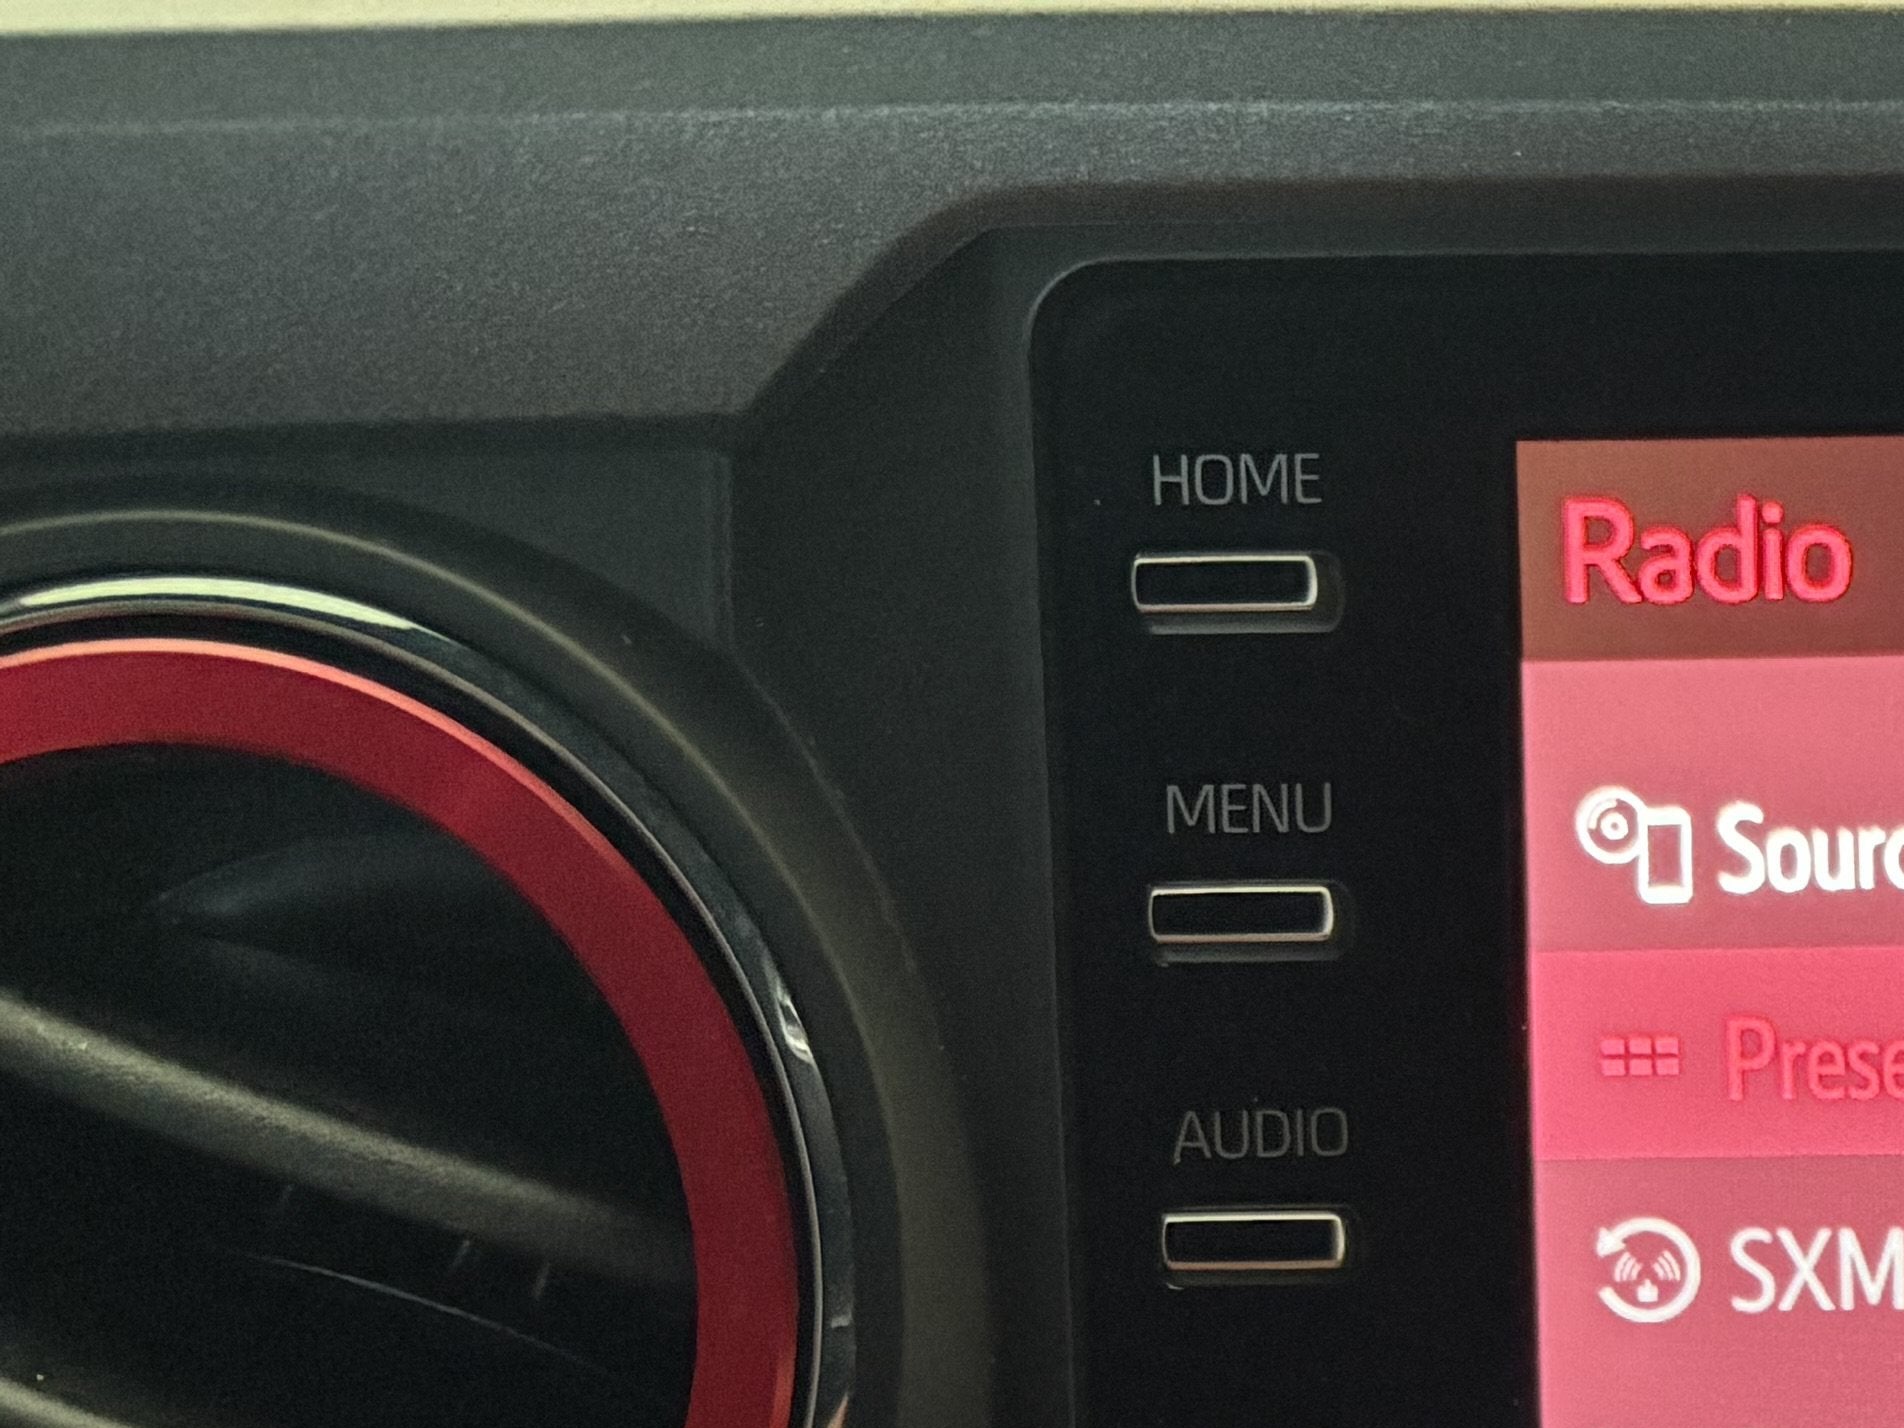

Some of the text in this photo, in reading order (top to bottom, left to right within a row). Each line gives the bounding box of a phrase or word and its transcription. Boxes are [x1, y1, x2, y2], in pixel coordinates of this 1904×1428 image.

[1152, 453, 1322, 506] HOME
[1562, 494, 1852, 604] Radio
[1165, 782, 1333, 835] MENU
[1174, 1107, 1349, 1165] AUDIO
